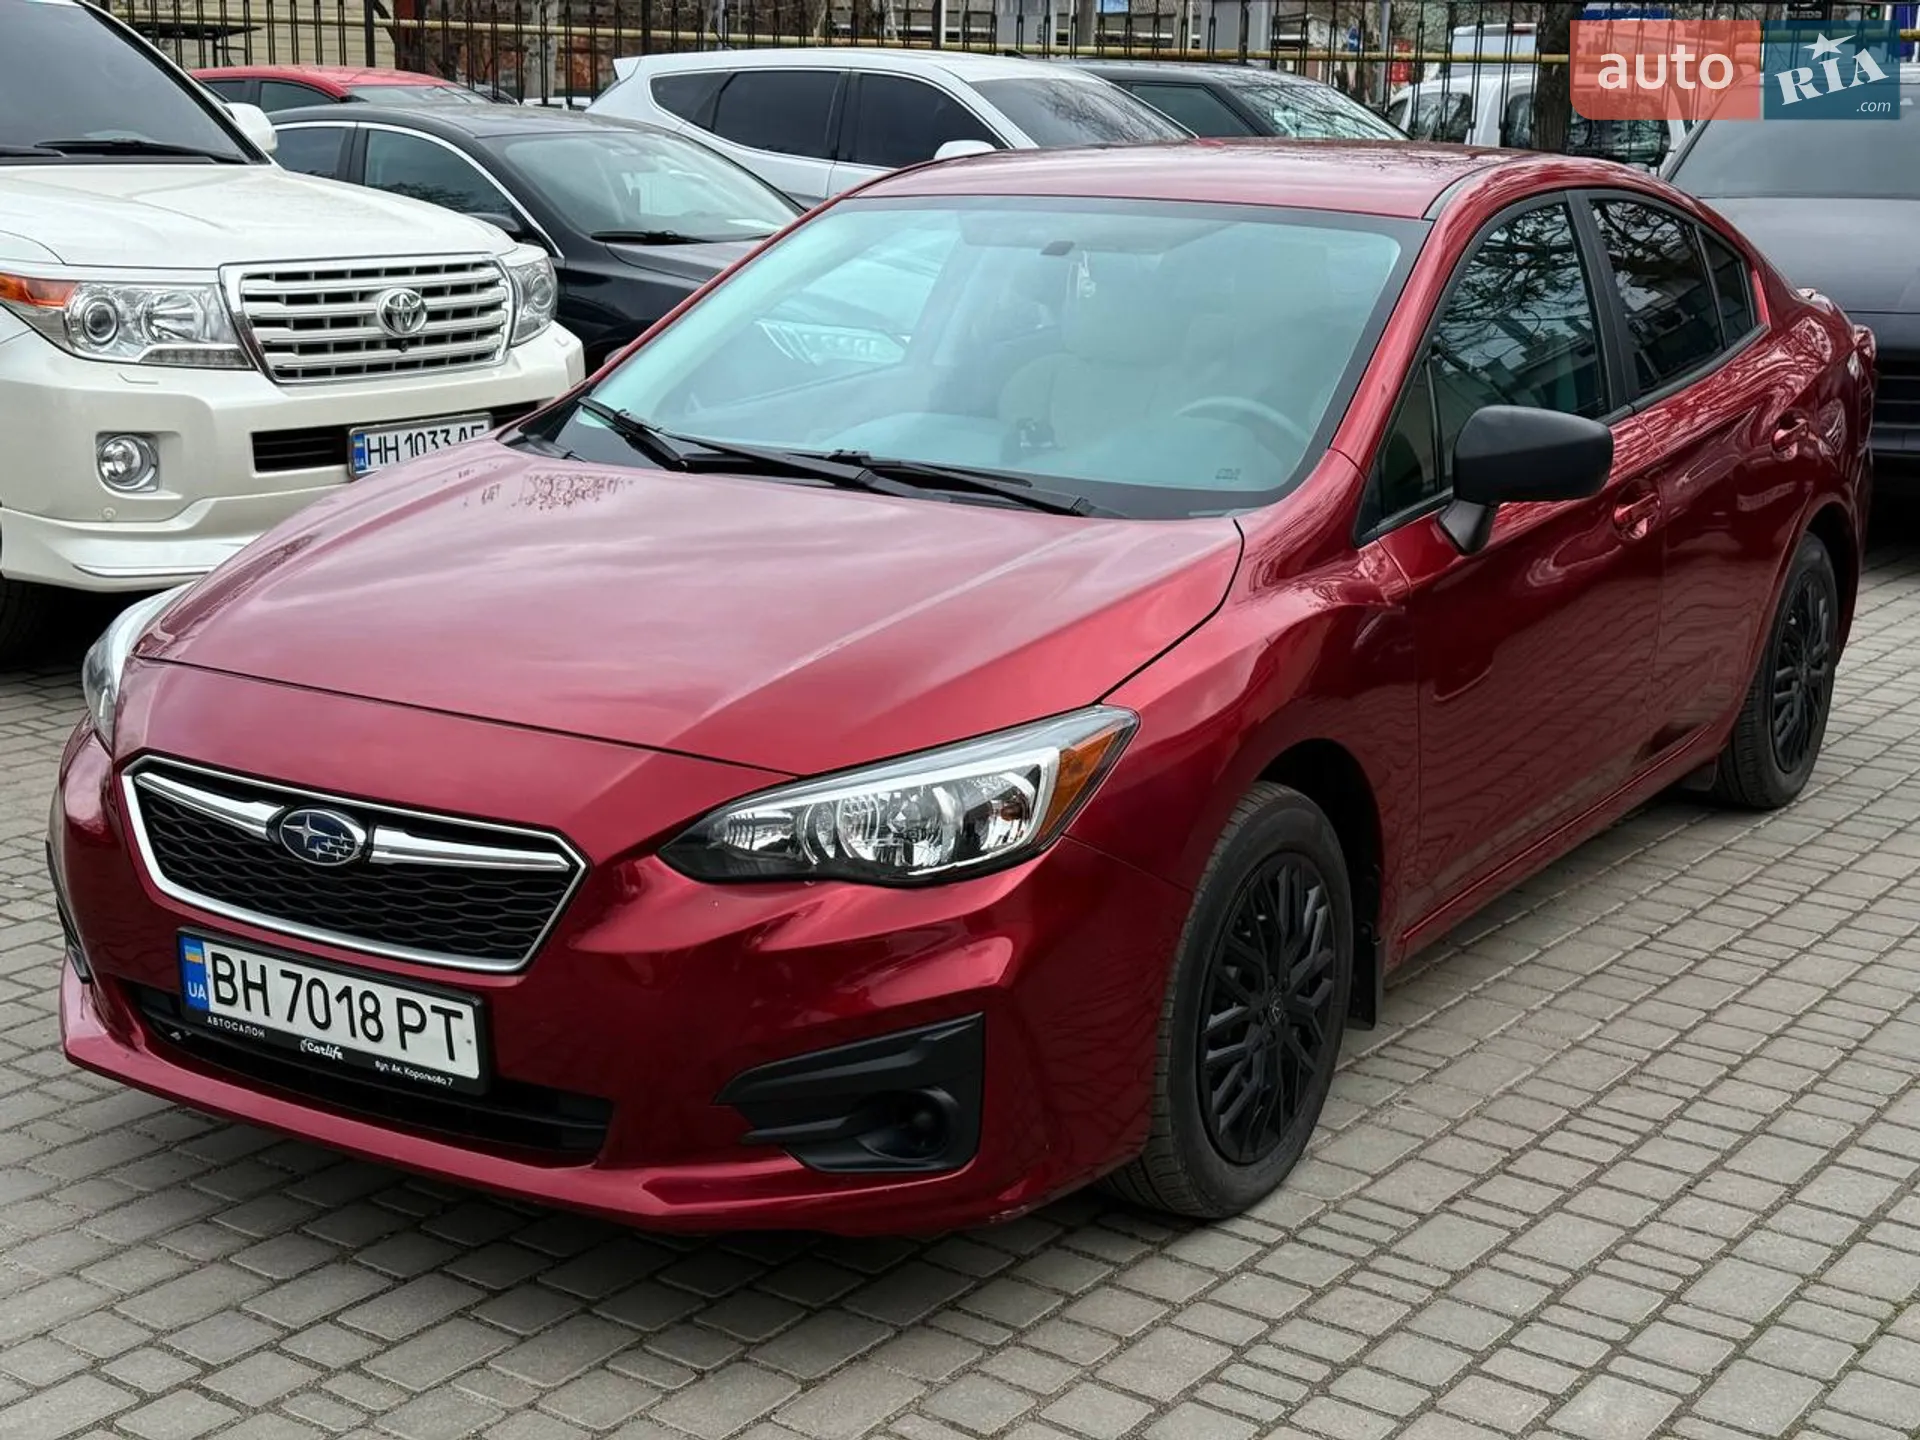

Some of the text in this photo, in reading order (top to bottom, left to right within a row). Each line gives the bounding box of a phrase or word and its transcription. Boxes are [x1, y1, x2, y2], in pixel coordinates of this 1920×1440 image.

[366, 434, 400, 465] HH
[187, 981, 207, 1001] UA
[210, 951, 463, 1061] BH 7018 PT
[207, 1016, 265, 1038] АВТОСАЛОН
